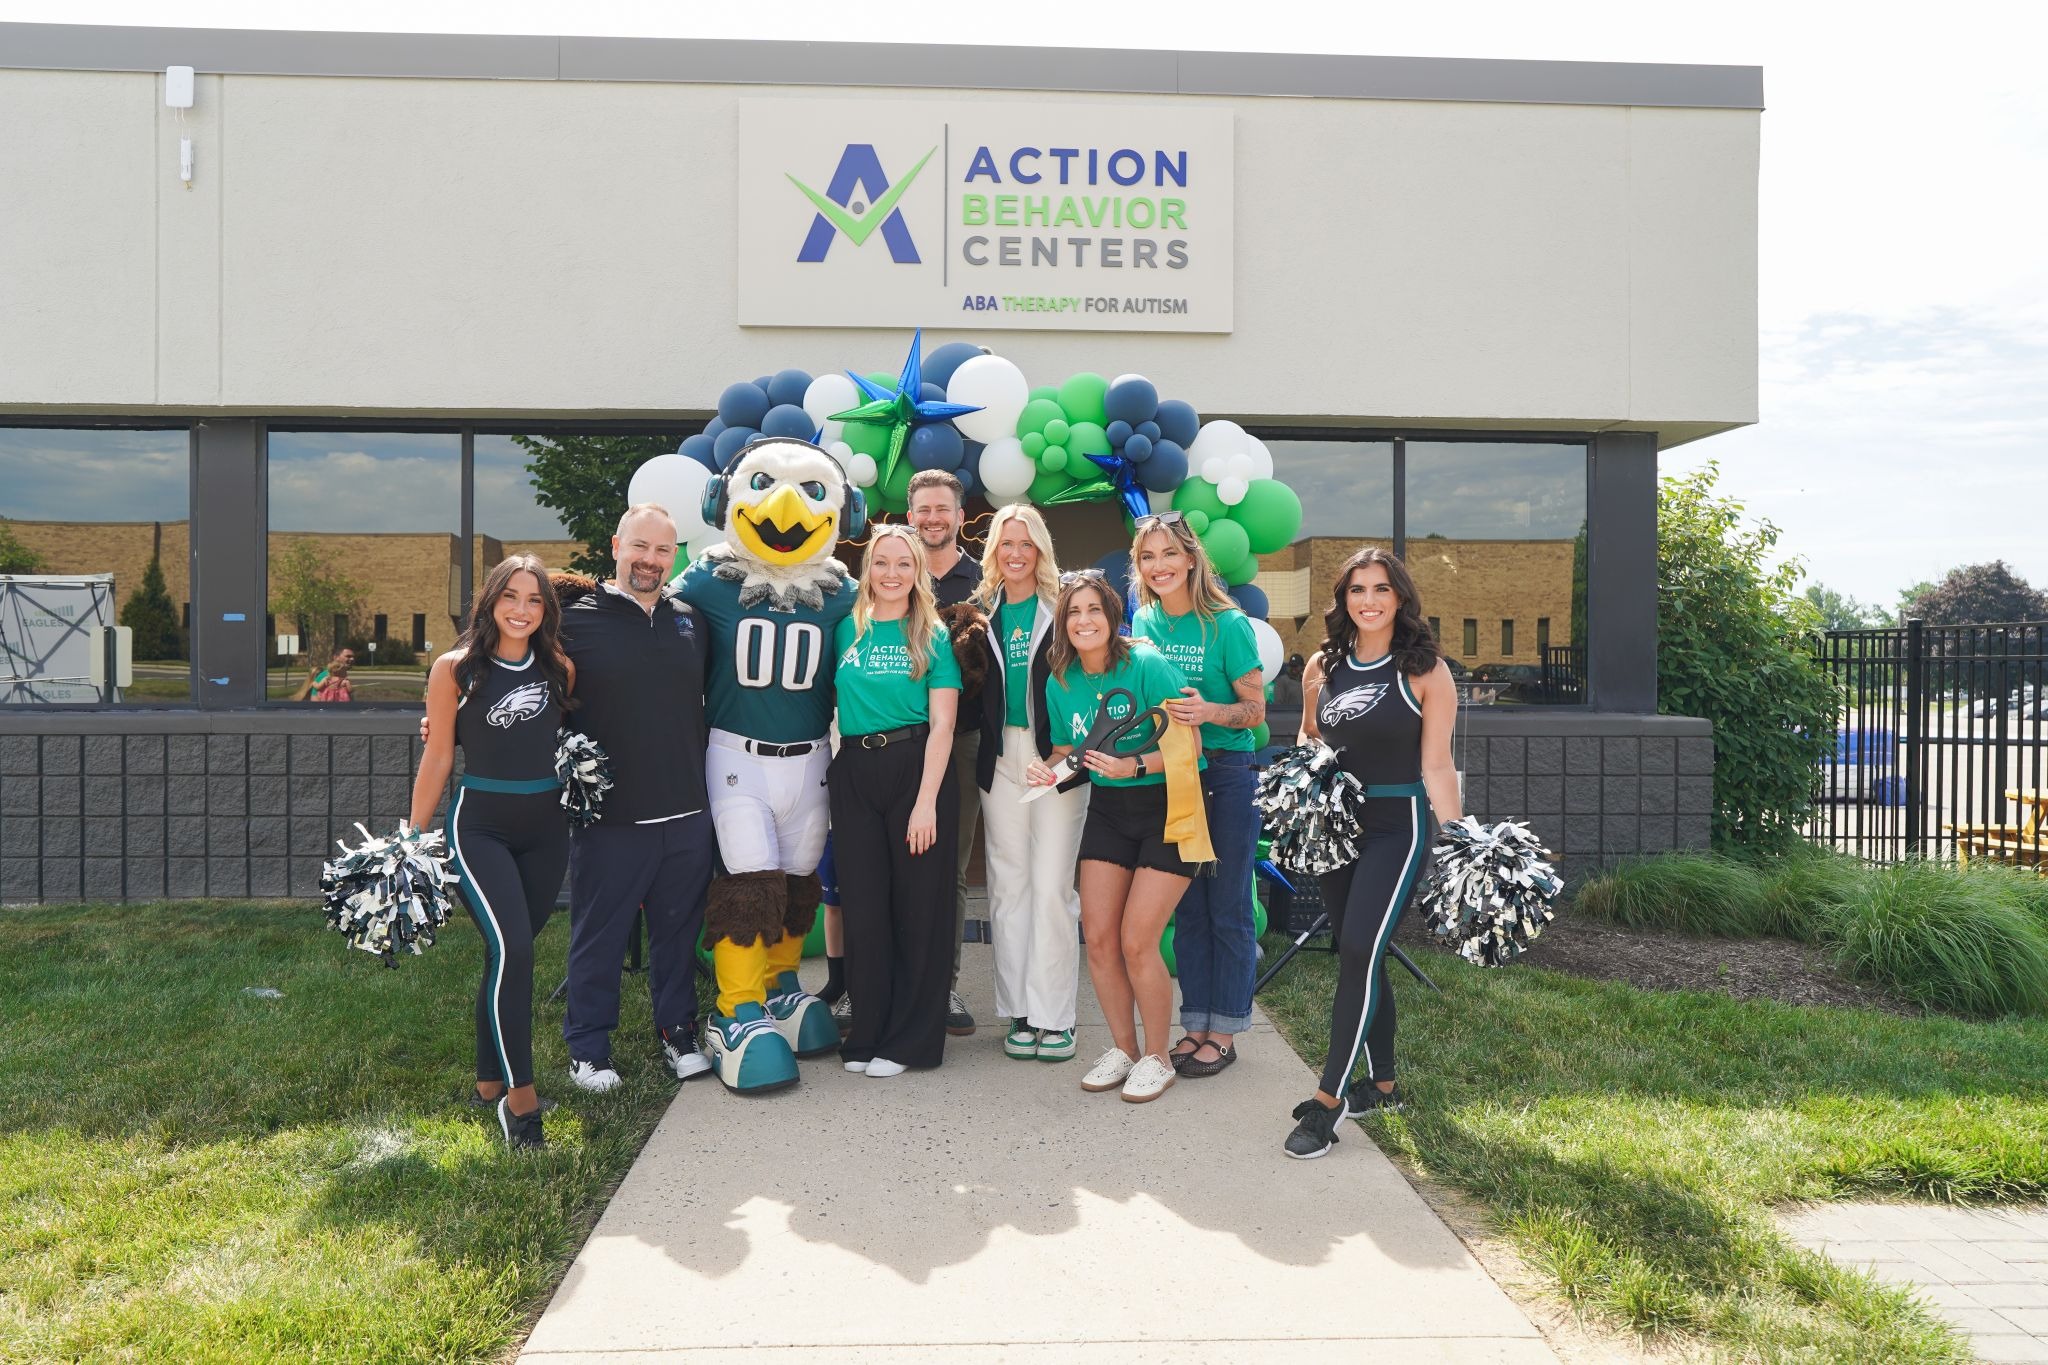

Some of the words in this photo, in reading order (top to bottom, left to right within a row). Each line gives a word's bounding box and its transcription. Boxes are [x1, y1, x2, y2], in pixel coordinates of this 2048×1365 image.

[964, 146, 1187, 187] ACTION
[962, 194, 1188, 229] BEHAVIOR
[962, 235, 1189, 269] CENTERS
[962, 295, 998, 311] ABA
[1002, 296, 1081, 312] THERAPY
[1085, 297, 1119, 313] FOR
[1122, 297, 1188, 313] AUTISM
[735, 617, 822, 691] 00
[872, 645, 908, 654] ACTIO
[1165, 653, 1204, 664] BEHAVIOR
[1166, 644, 1205, 655] ACTION
[1179, 663, 1204, 672] TERS
